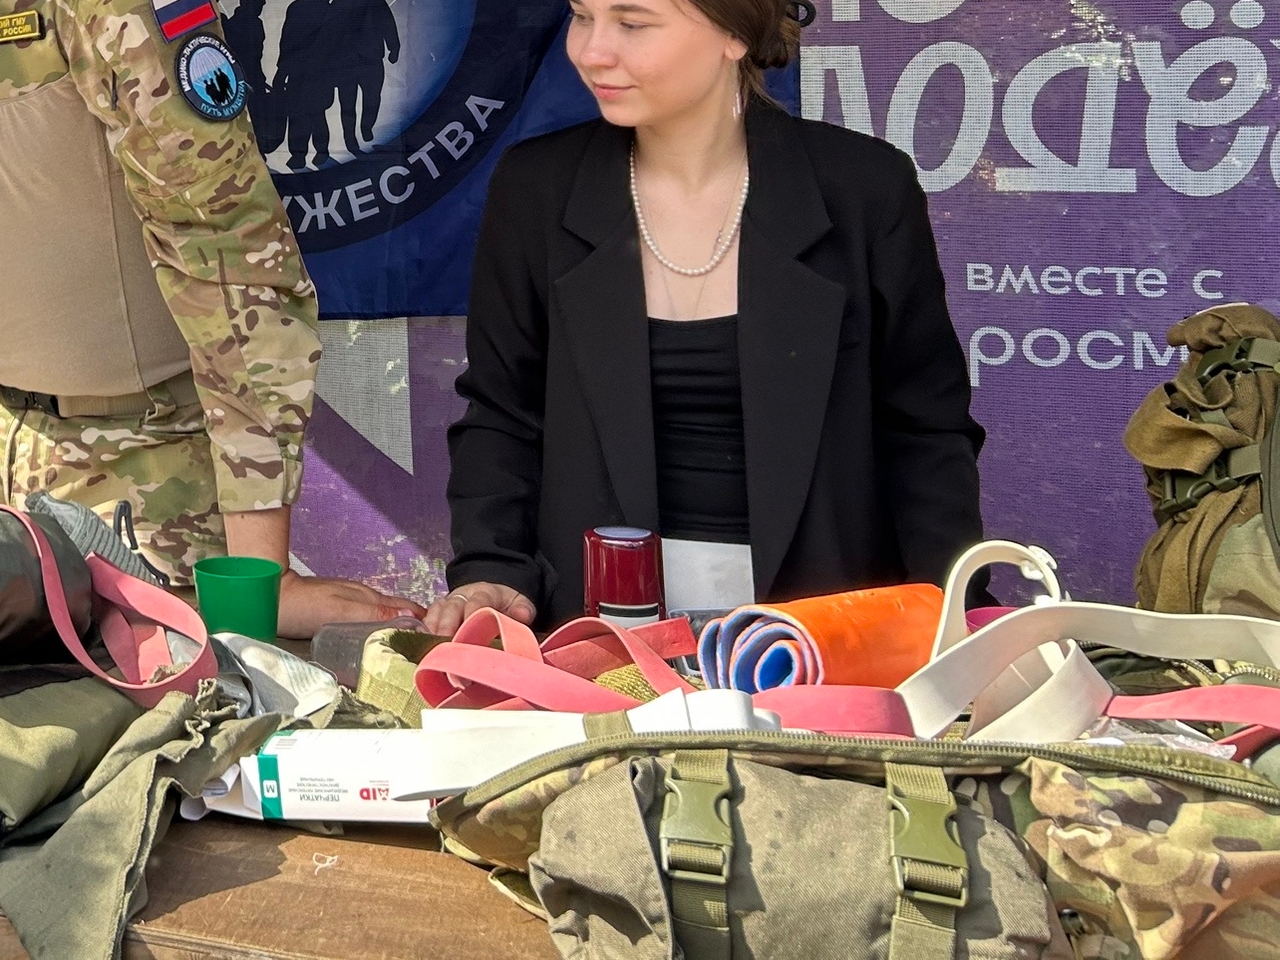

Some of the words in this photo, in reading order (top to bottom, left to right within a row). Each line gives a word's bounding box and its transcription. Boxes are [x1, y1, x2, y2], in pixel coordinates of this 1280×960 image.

[11, 17, 27, 29] ГМУ
[3, 24, 32, 38] РОССИИ
[219, 44, 237, 64] ИГРЫ
[201, 102, 222, 117] ПУТЬ
[222, 80, 246, 117] МУЖЕСТВА
[966, 262, 1167, 298] вместе
[1192, 269, 1224, 299] с
[266, 784, 276, 794] M
[299, 793, 340, 803] ПЕРЧАТКИ
